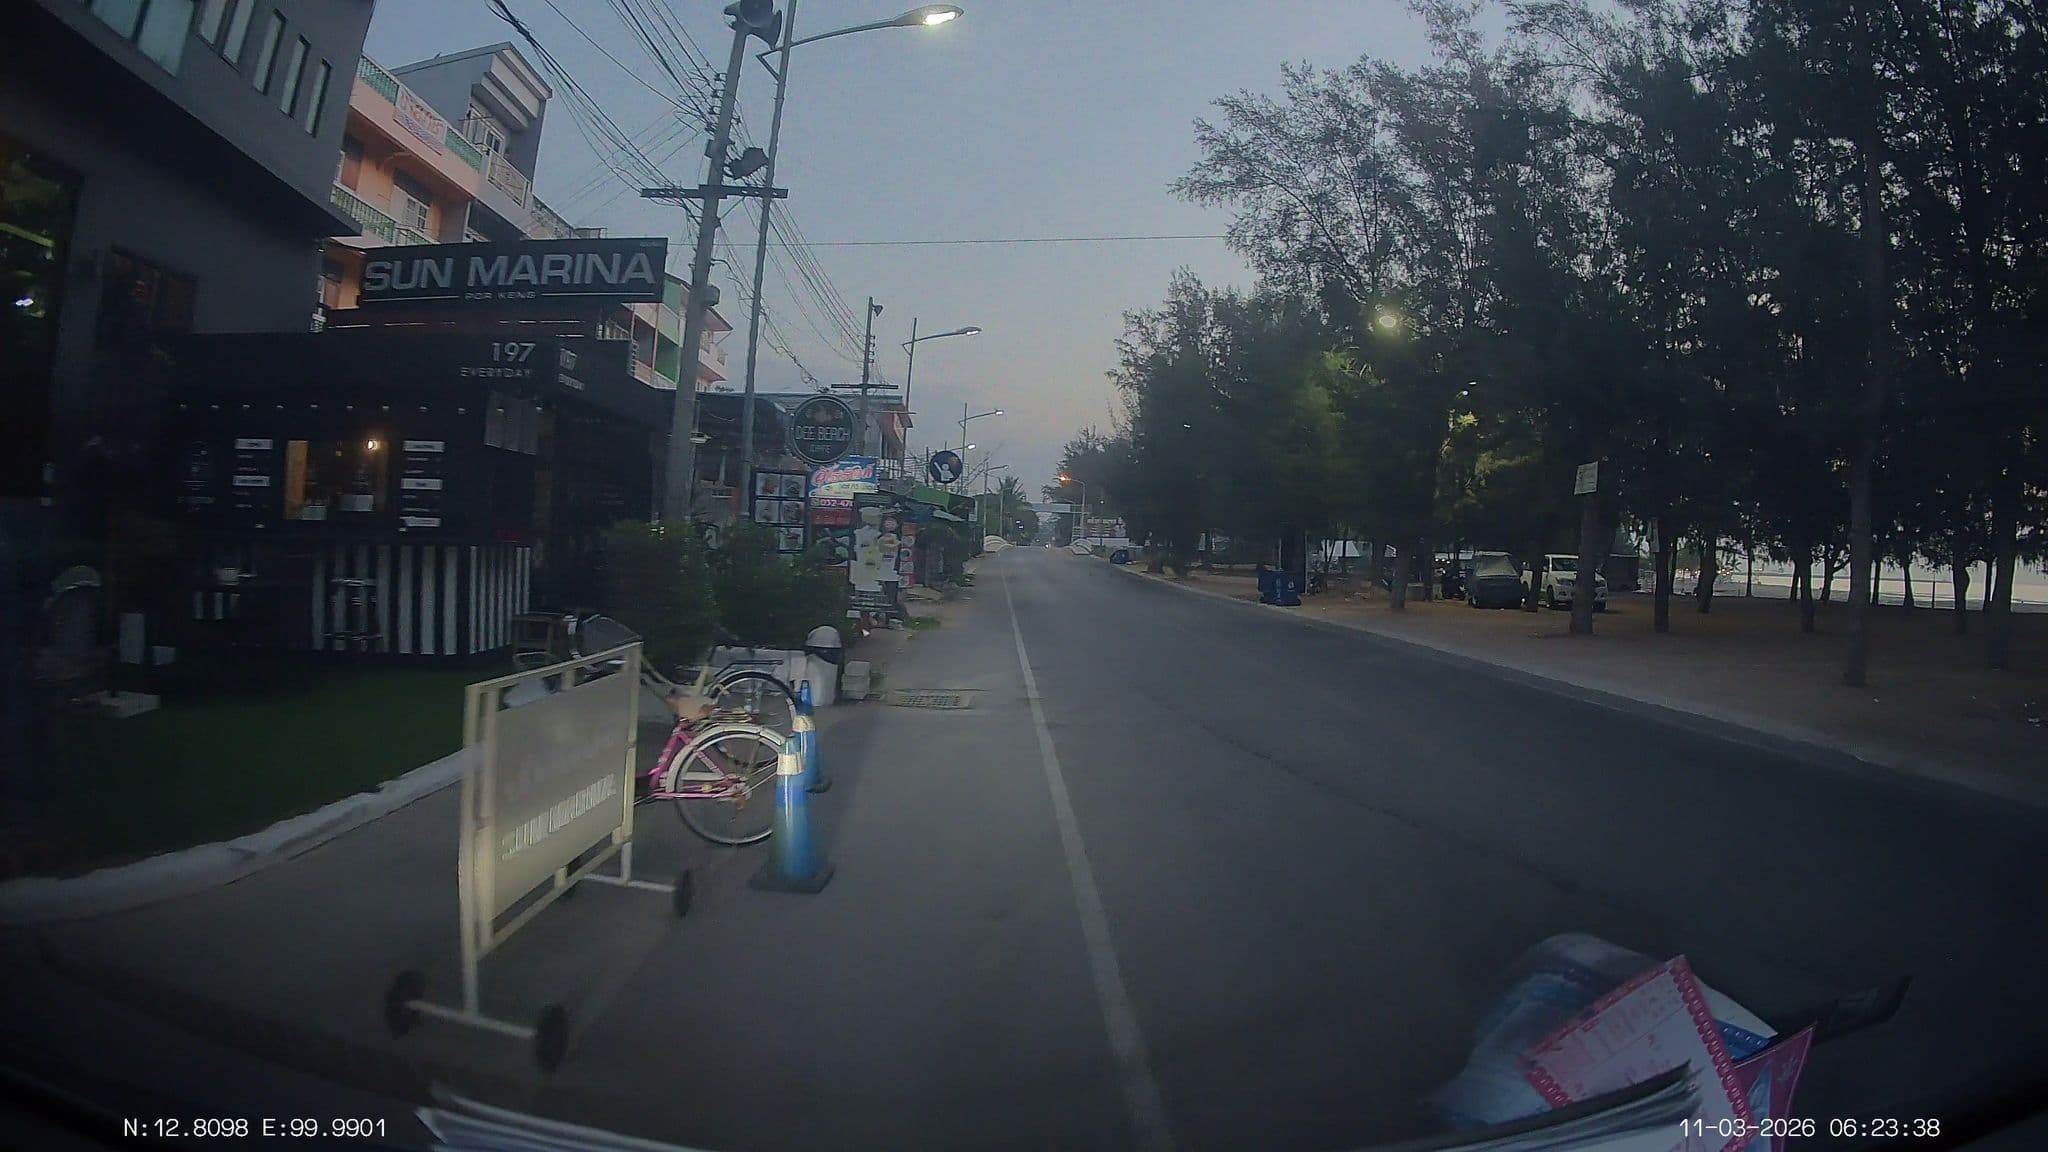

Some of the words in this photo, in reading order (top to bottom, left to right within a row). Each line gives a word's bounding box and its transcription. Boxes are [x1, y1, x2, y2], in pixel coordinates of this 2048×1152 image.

[364, 257, 453, 291] SUN
[466, 252, 656, 287] MARINA
[491, 342, 536, 362] 197
